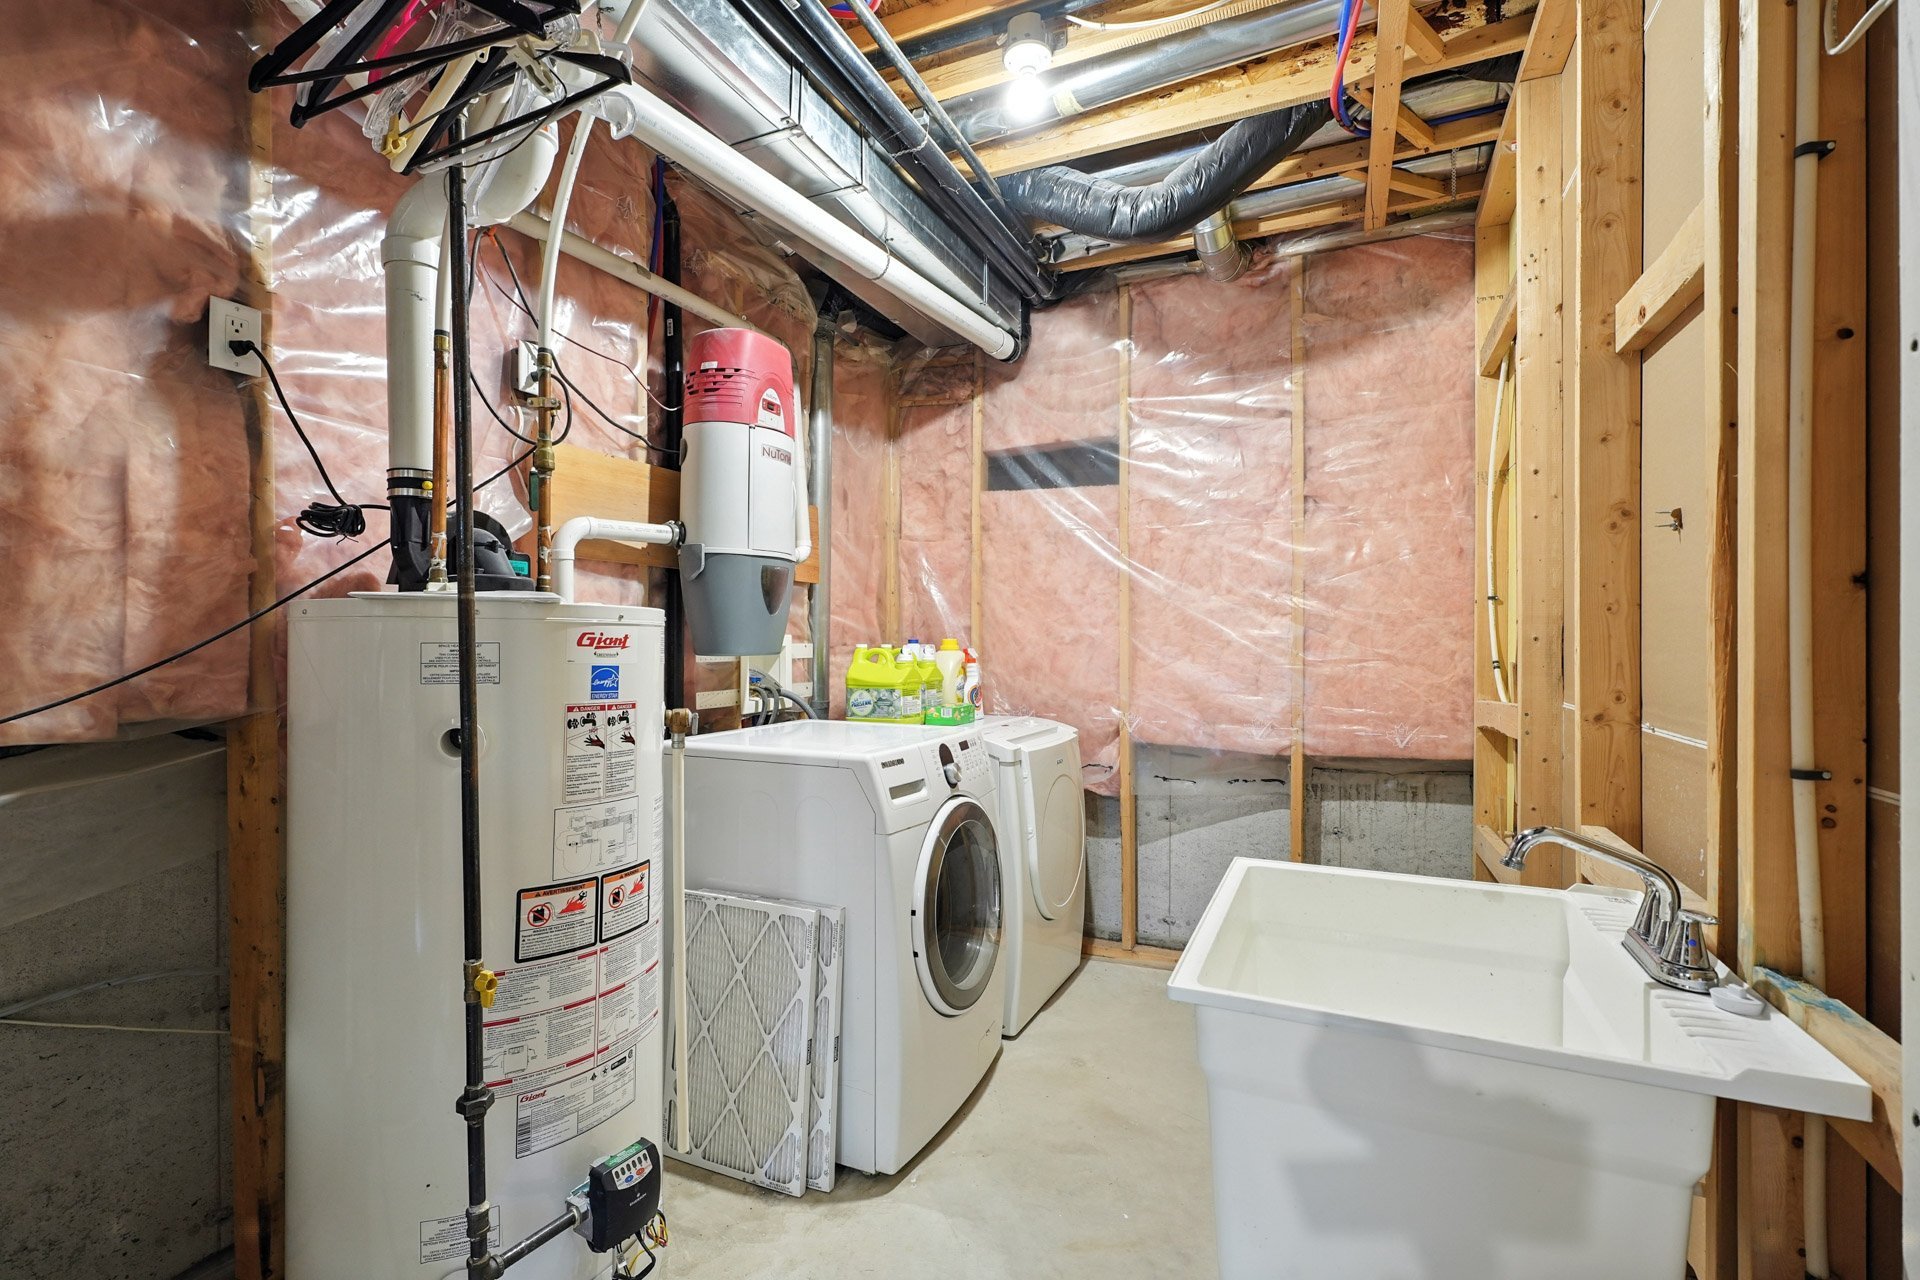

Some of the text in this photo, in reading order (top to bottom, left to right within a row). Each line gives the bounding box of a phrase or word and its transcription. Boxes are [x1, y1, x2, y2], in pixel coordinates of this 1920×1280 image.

[762, 446, 791, 465] NuTone
[576, 632, 631, 649] Giant
[624, 869, 640, 877] WARNING
[542, 884, 586, 896] AVERTISSEMENT
[520, 1090, 547, 1103] Giant
